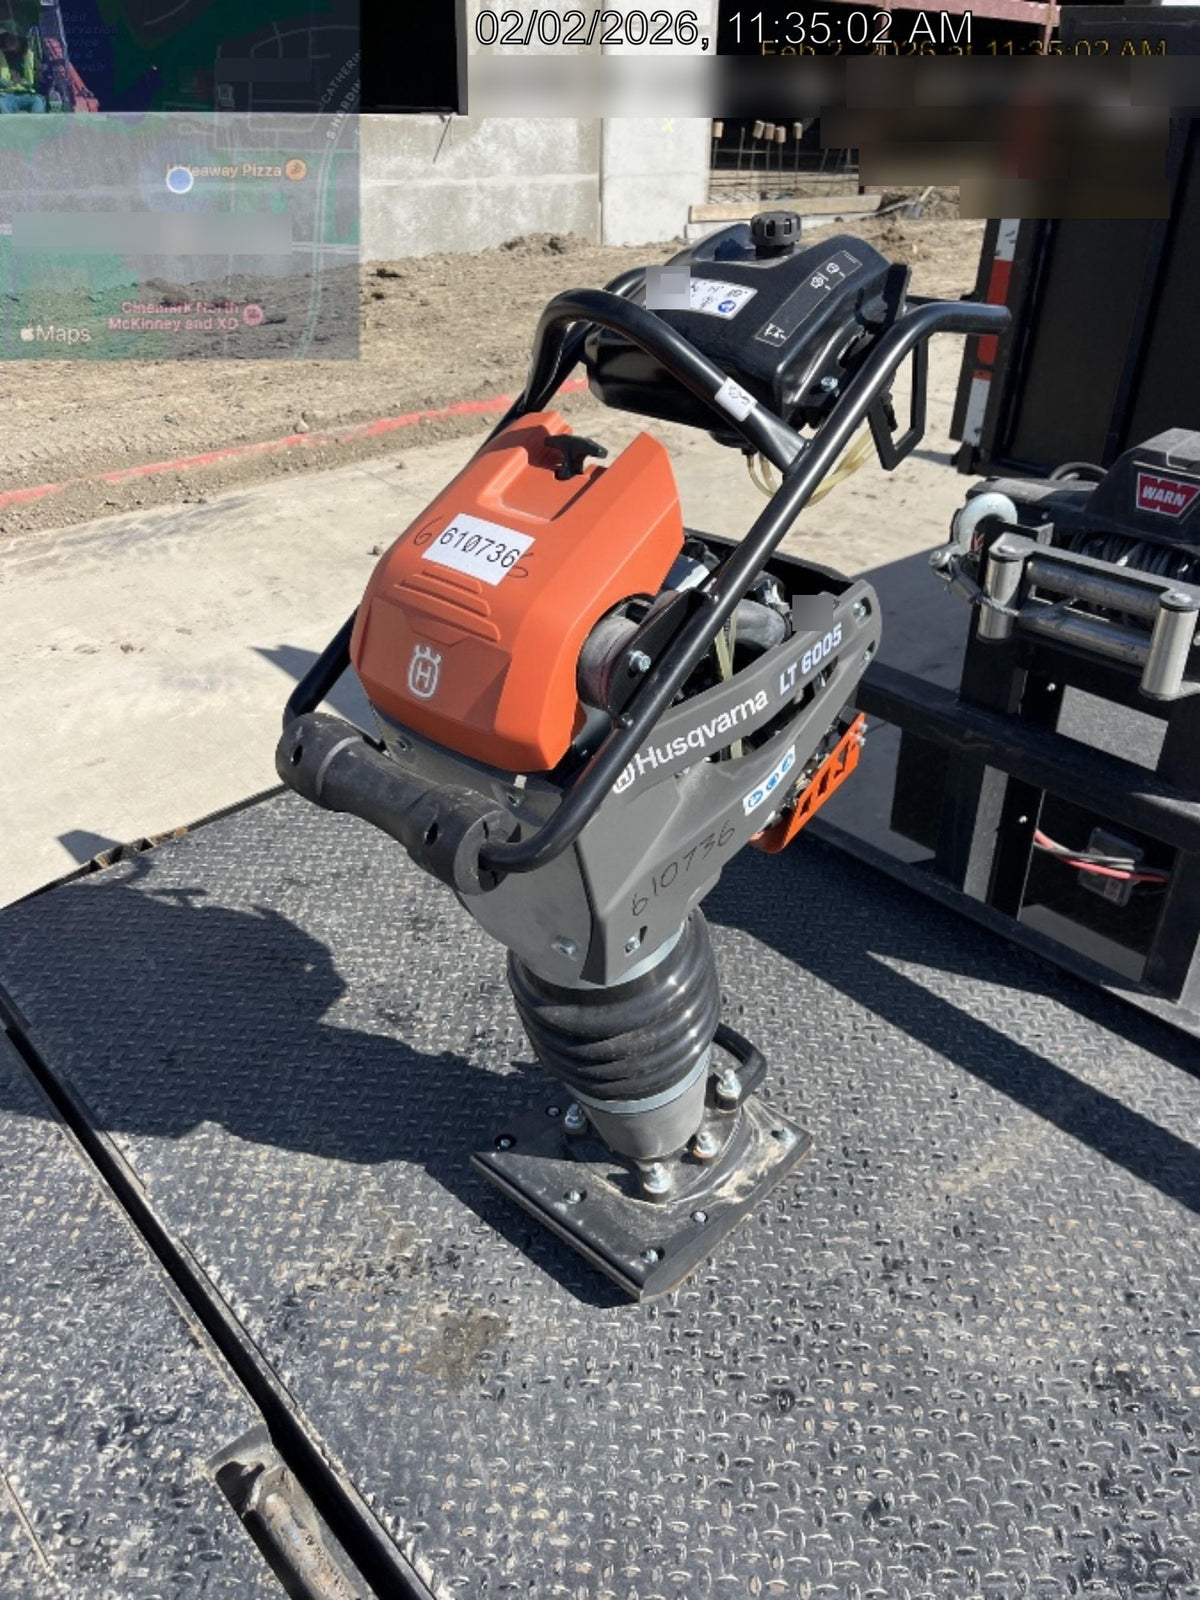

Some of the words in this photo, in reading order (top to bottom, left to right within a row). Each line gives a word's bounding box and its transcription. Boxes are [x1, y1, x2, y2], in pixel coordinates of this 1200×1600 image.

[1141, 485, 1187, 507] WARN
[440, 526, 521, 569] 610736
[778, 661, 800, 697] LT
[800, 622, 843, 676] 6005
[635, 687, 769, 777] Husqvarna
[631, 819, 736, 918] 610736
